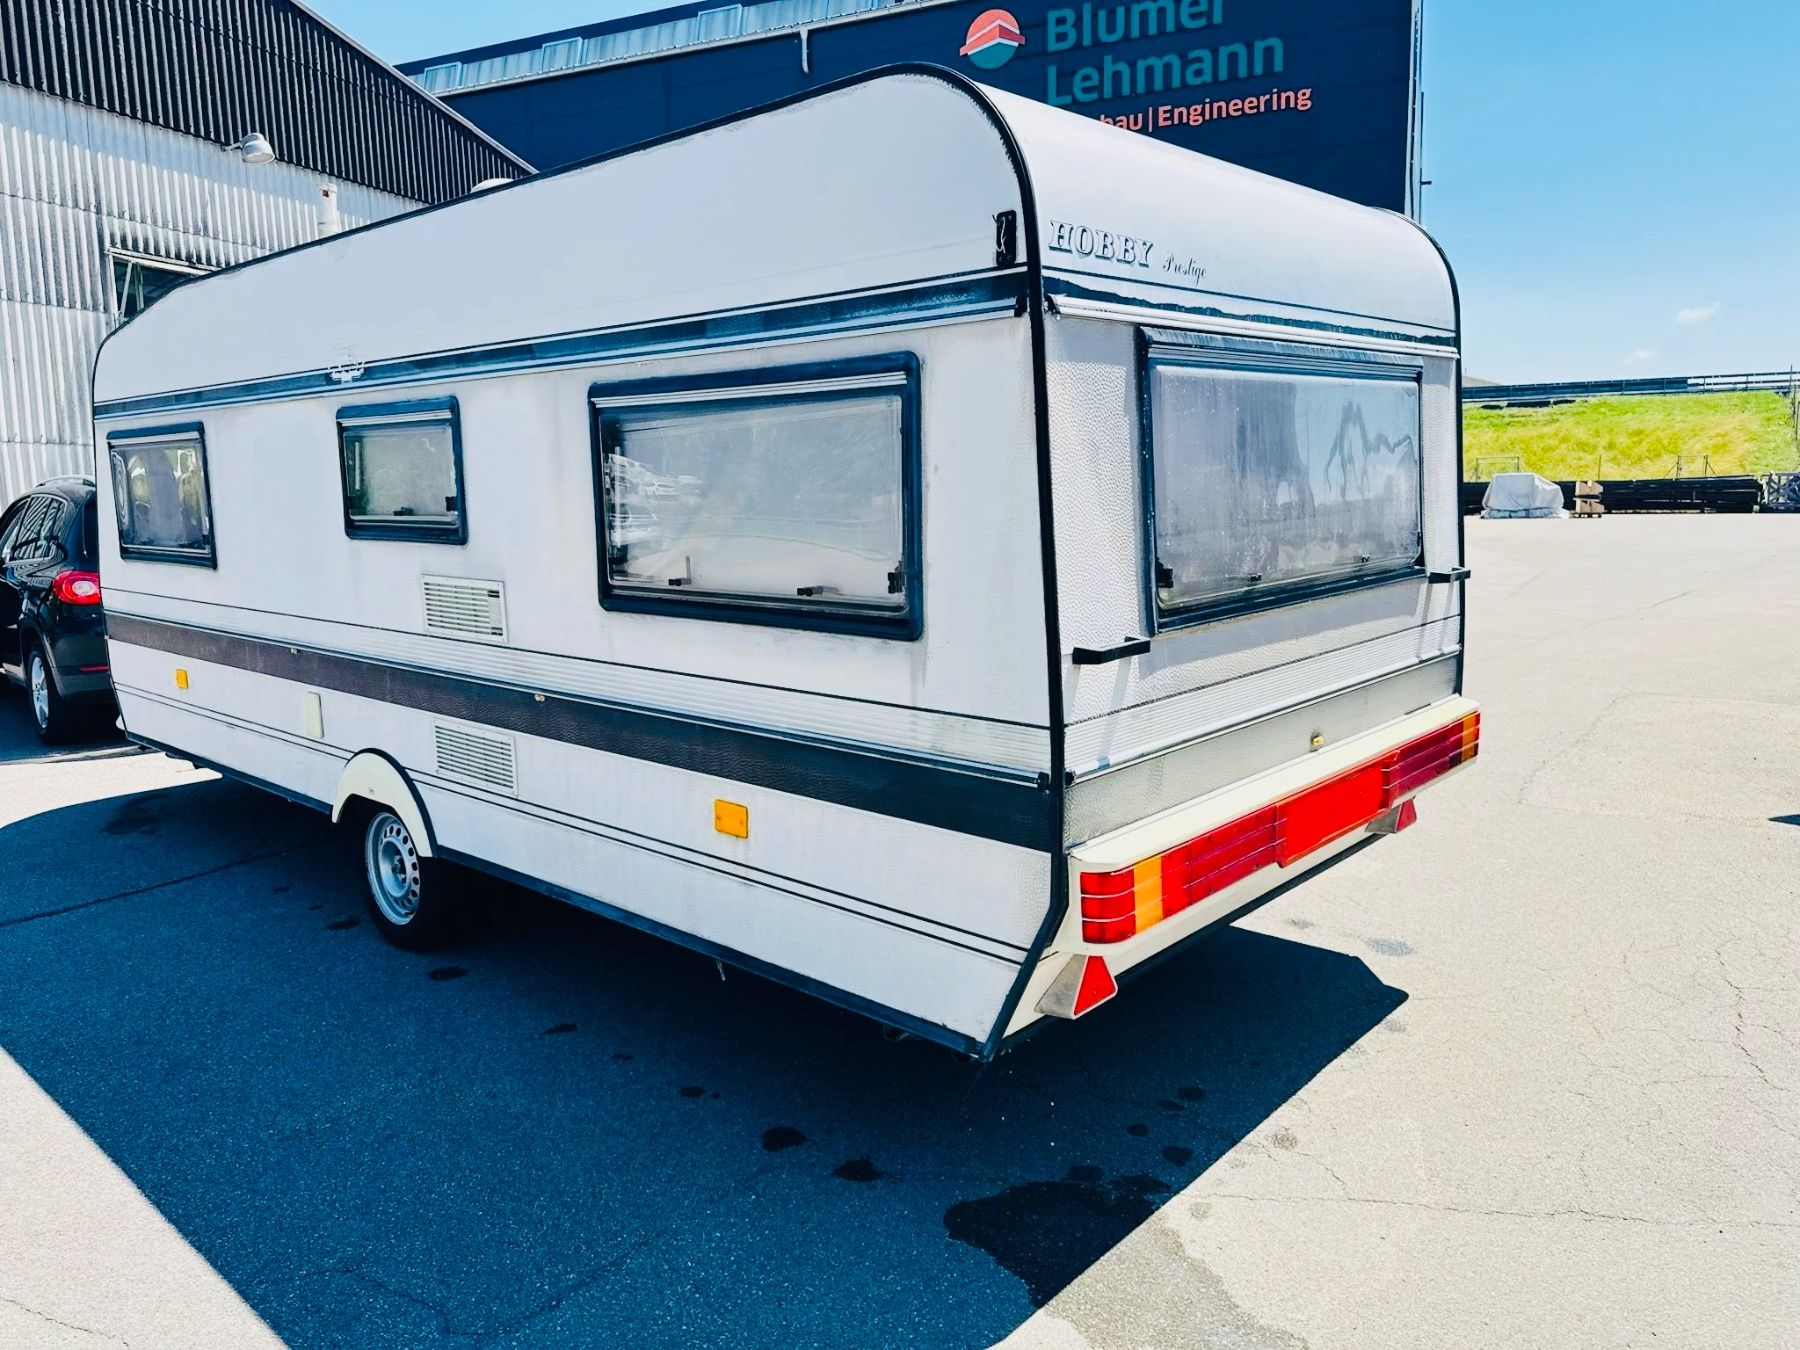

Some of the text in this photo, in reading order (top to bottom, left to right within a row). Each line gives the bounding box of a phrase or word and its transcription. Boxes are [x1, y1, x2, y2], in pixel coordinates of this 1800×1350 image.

[1047, 0, 1225, 52] Blumer
[1047, 37, 1284, 106] Lehmann
[1158, 88, 1312, 127] Engineering
[1049, 221, 1207, 286] HOBBY Prestige
